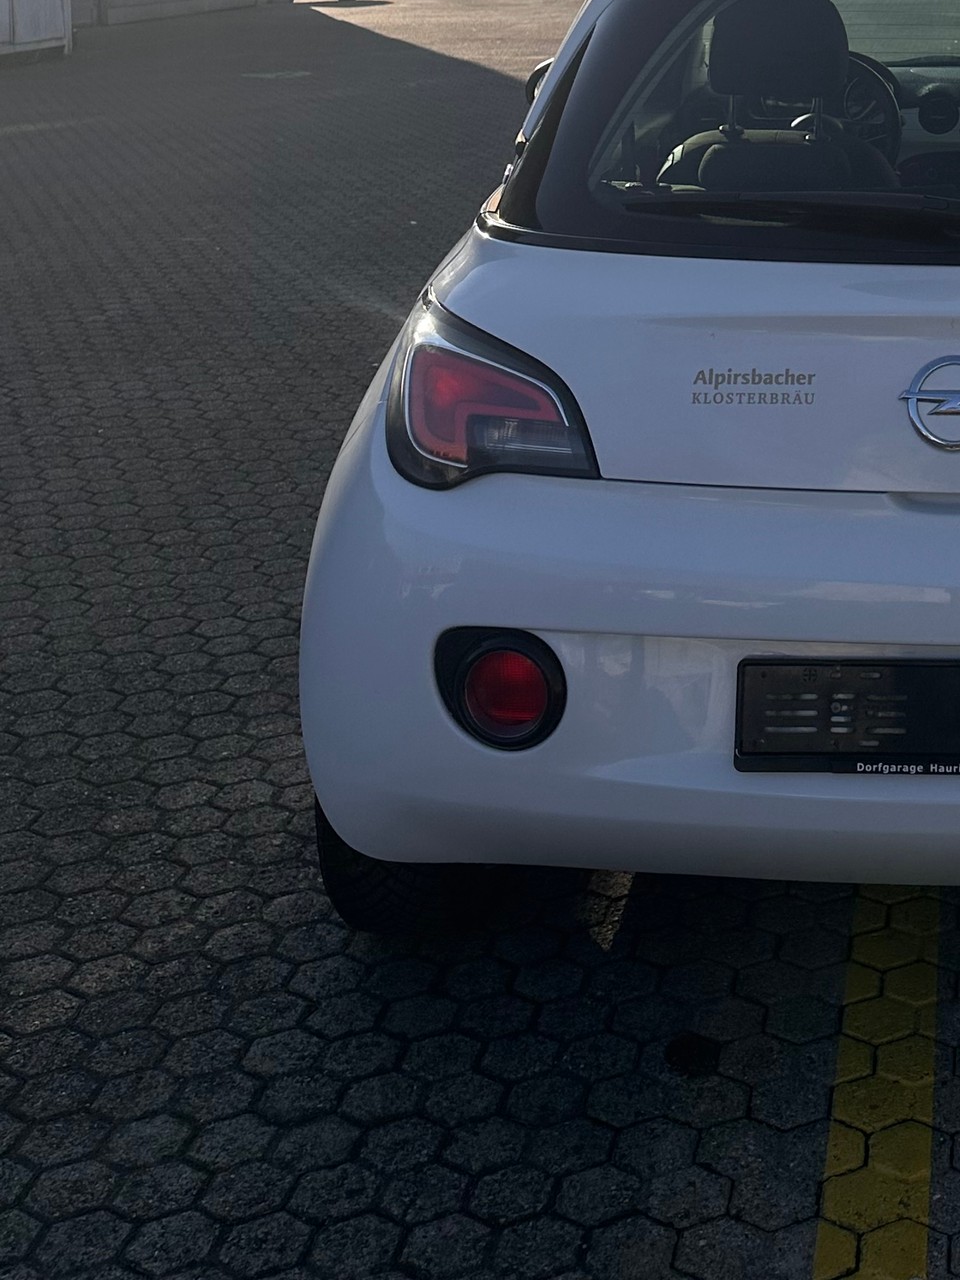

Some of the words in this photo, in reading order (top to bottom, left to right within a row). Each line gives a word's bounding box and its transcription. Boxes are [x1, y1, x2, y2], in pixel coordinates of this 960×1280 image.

[693, 368, 816, 390] Alpirsbacher
[692, 390, 816, 405] KLOSTERBRÄU
[856, 762, 924, 775] Dorfgarage
